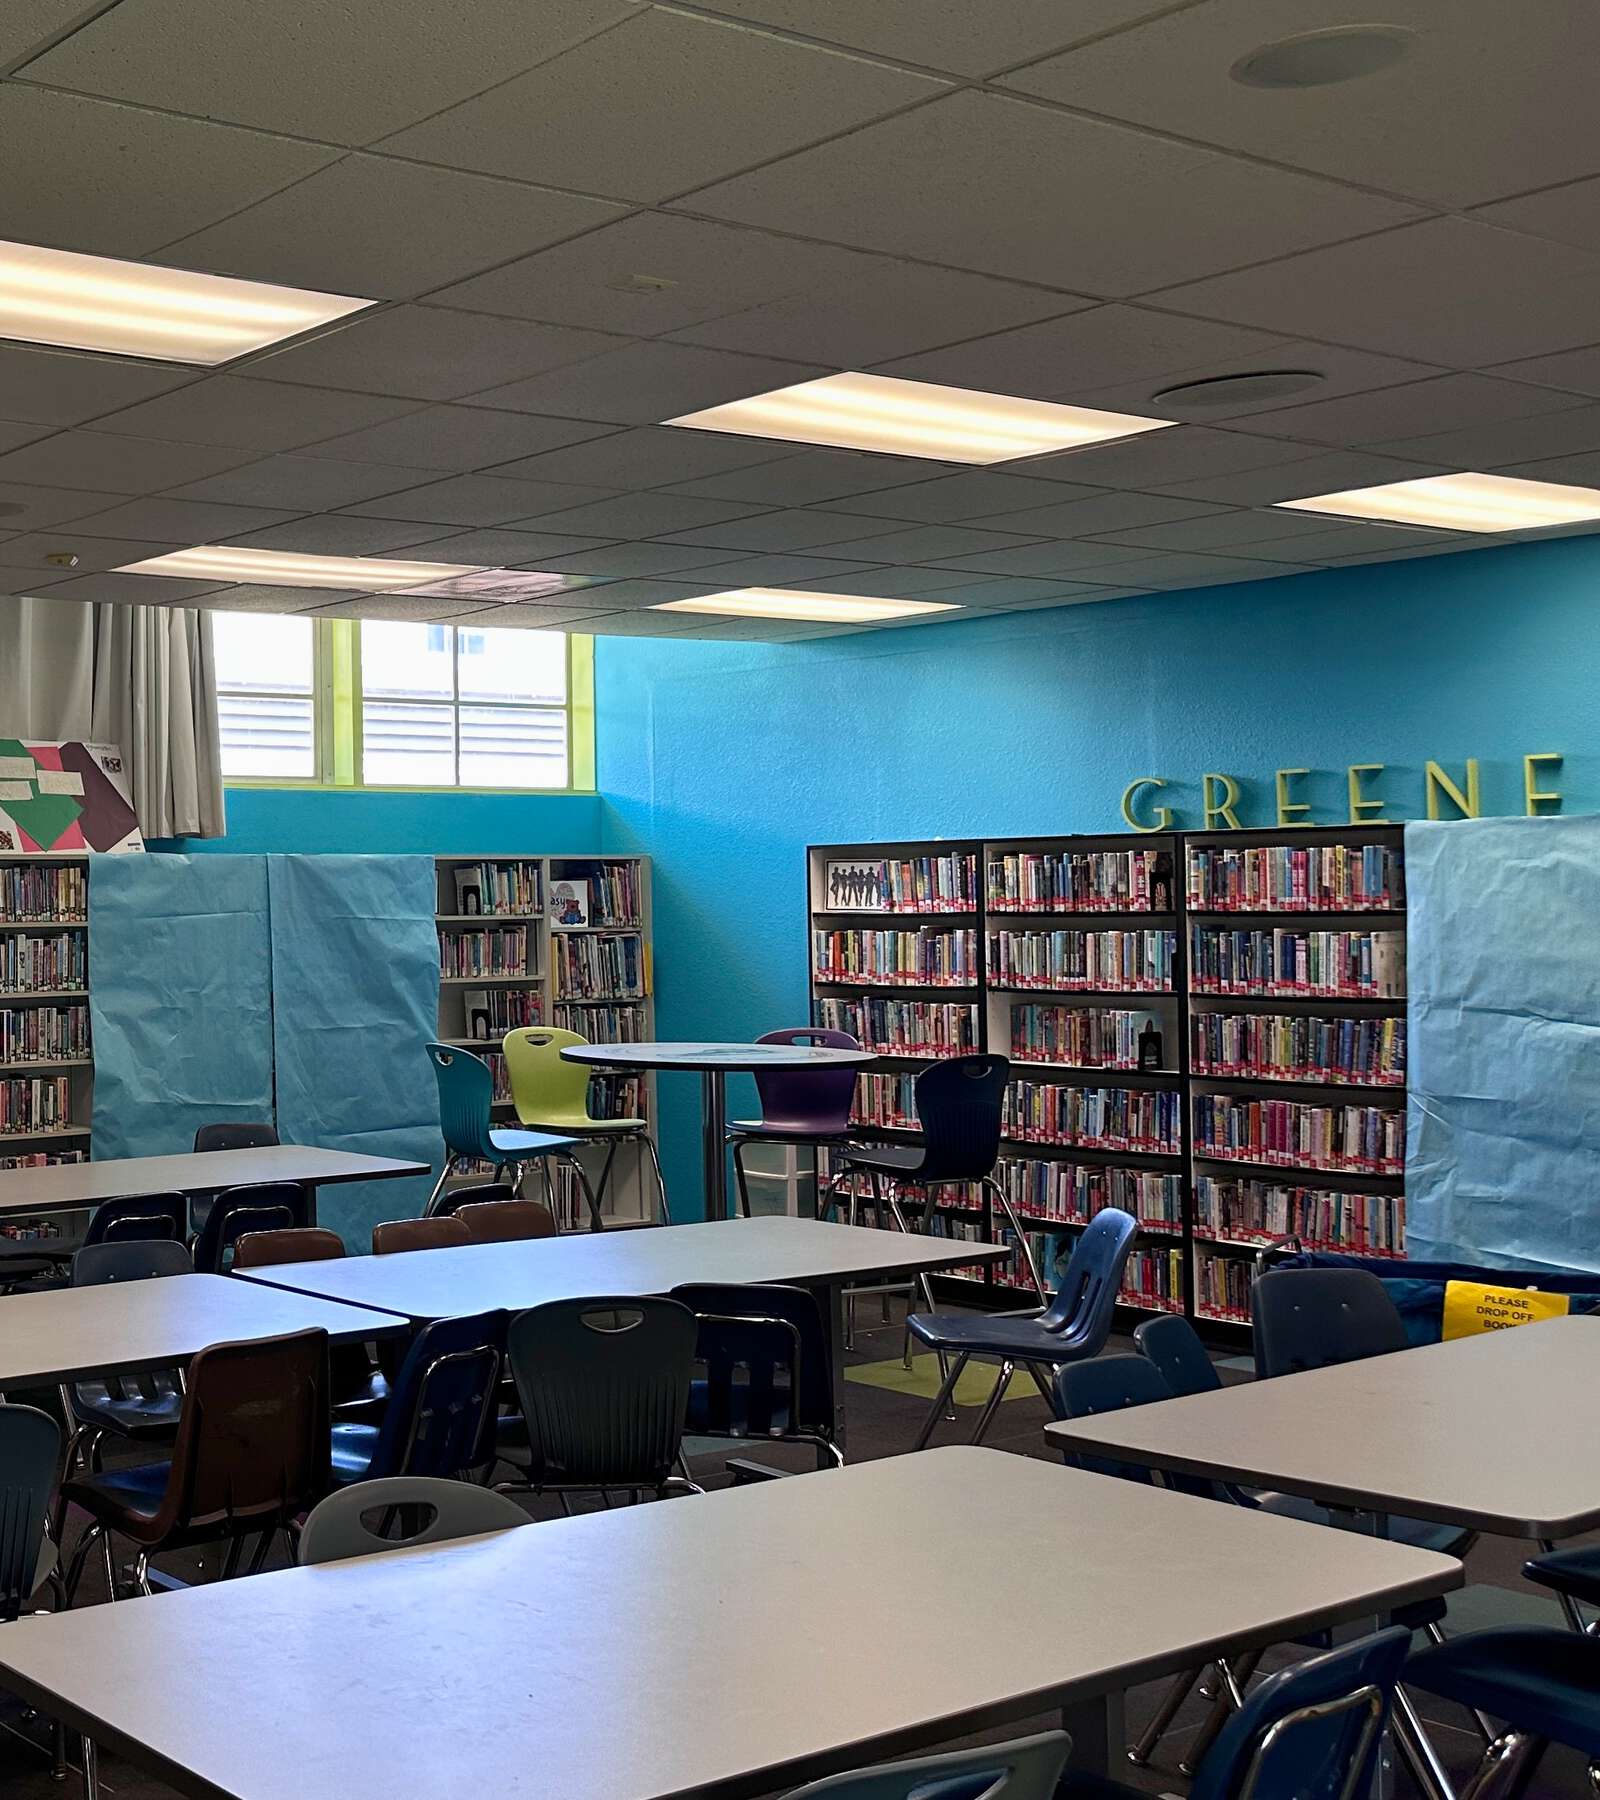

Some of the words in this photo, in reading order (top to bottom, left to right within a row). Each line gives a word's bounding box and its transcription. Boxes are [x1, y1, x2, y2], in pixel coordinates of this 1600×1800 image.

[550, 896, 566, 910] asy
[1484, 1295, 1529, 1308] PLEASE
[1476, 1306, 1509, 1317] DROP
[1512, 1312, 1534, 1321] OFF
